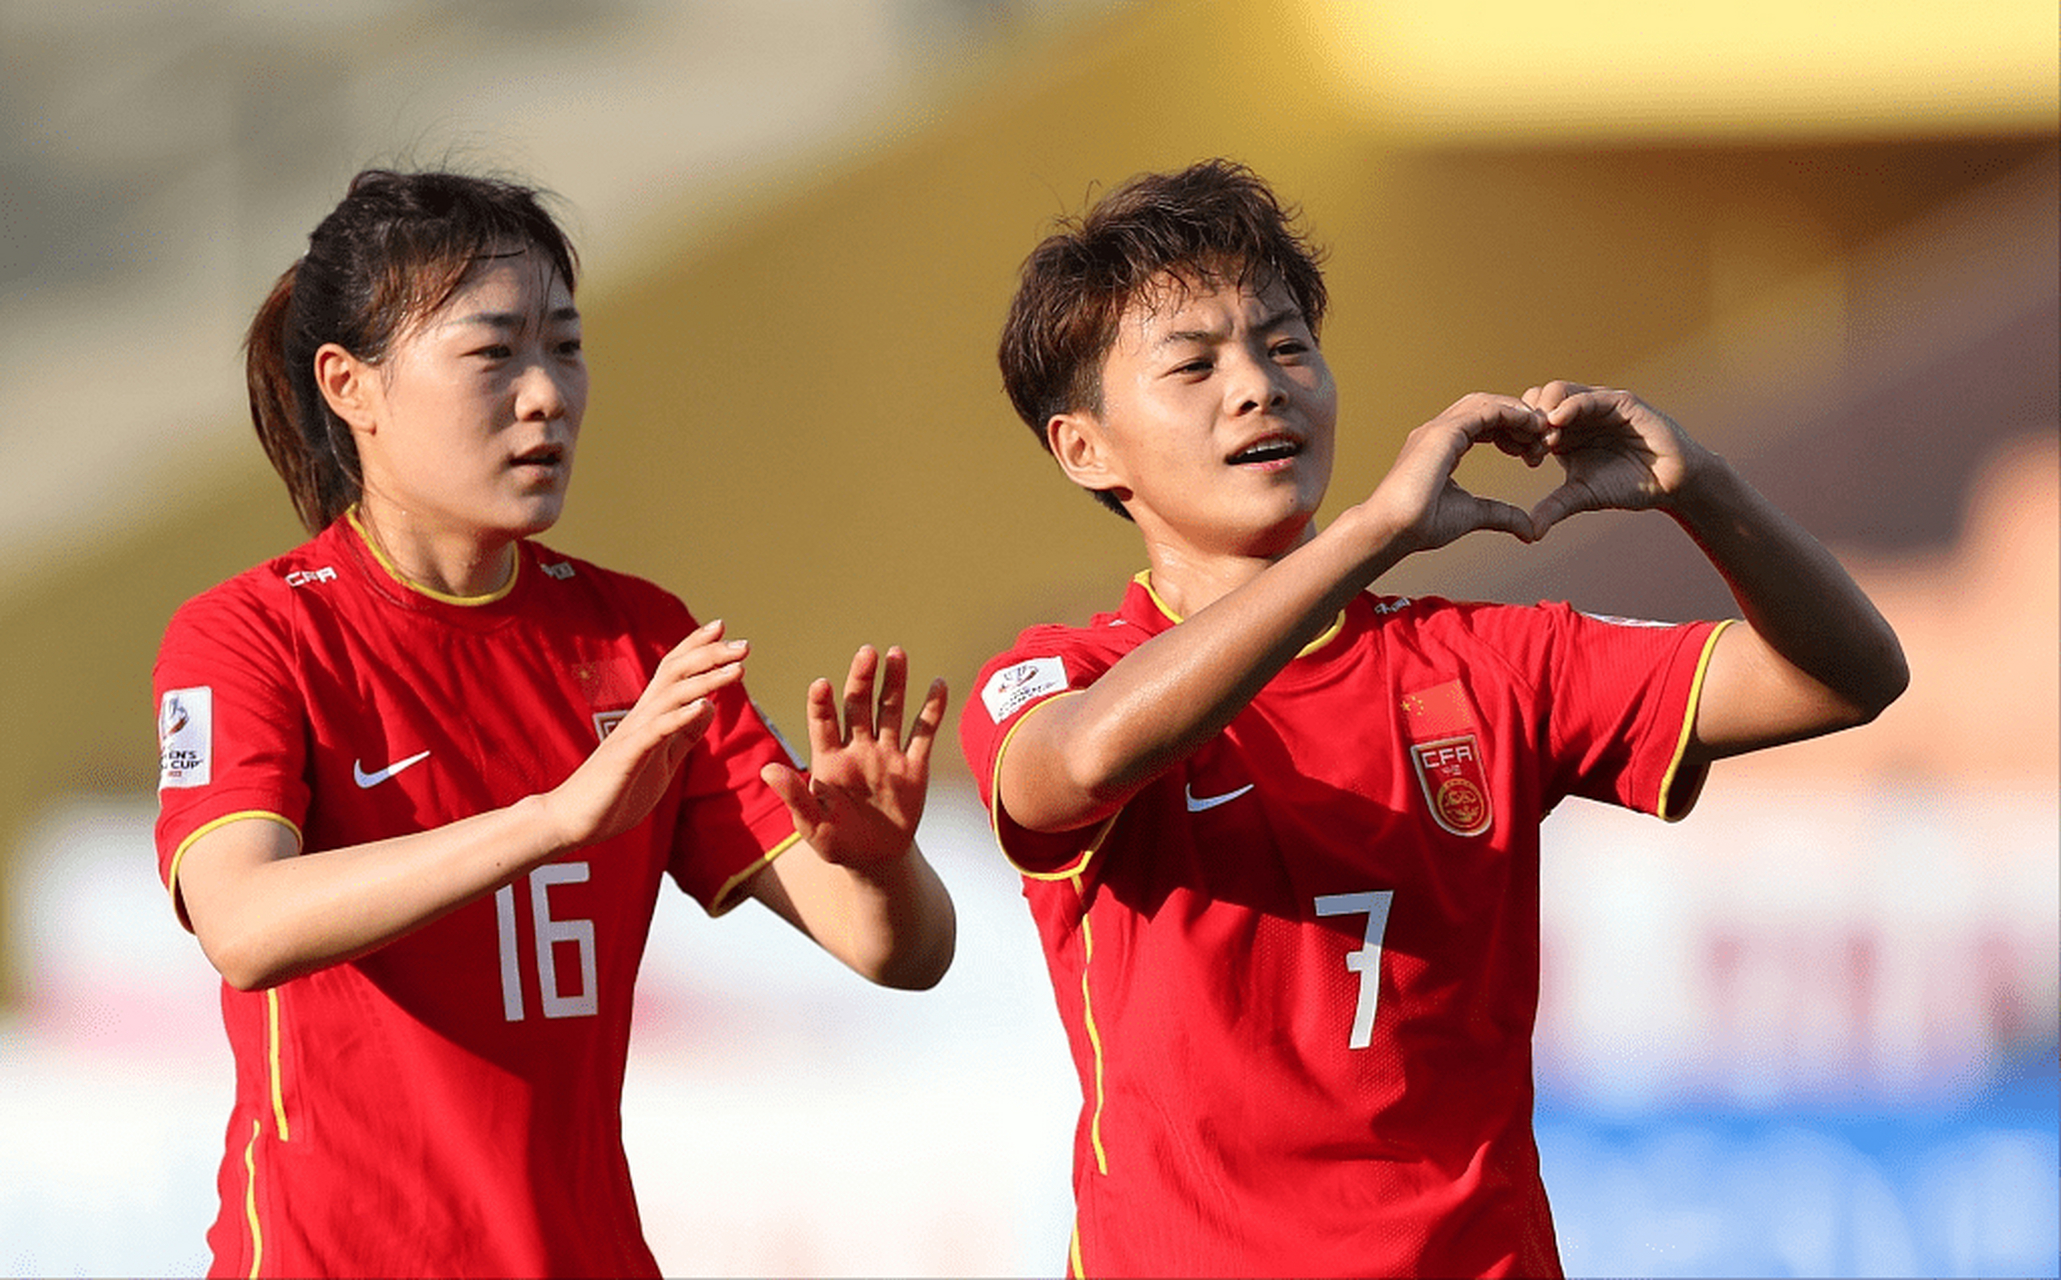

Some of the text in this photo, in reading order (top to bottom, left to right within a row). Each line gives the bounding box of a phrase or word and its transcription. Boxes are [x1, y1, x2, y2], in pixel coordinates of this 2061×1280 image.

[285, 566, 337, 587] CFA
[171, 760, 201, 770] CUP
[1421, 746, 1473, 769] CFA
[495, 861, 598, 1022] 16
[1313, 890, 1394, 1049] 7
